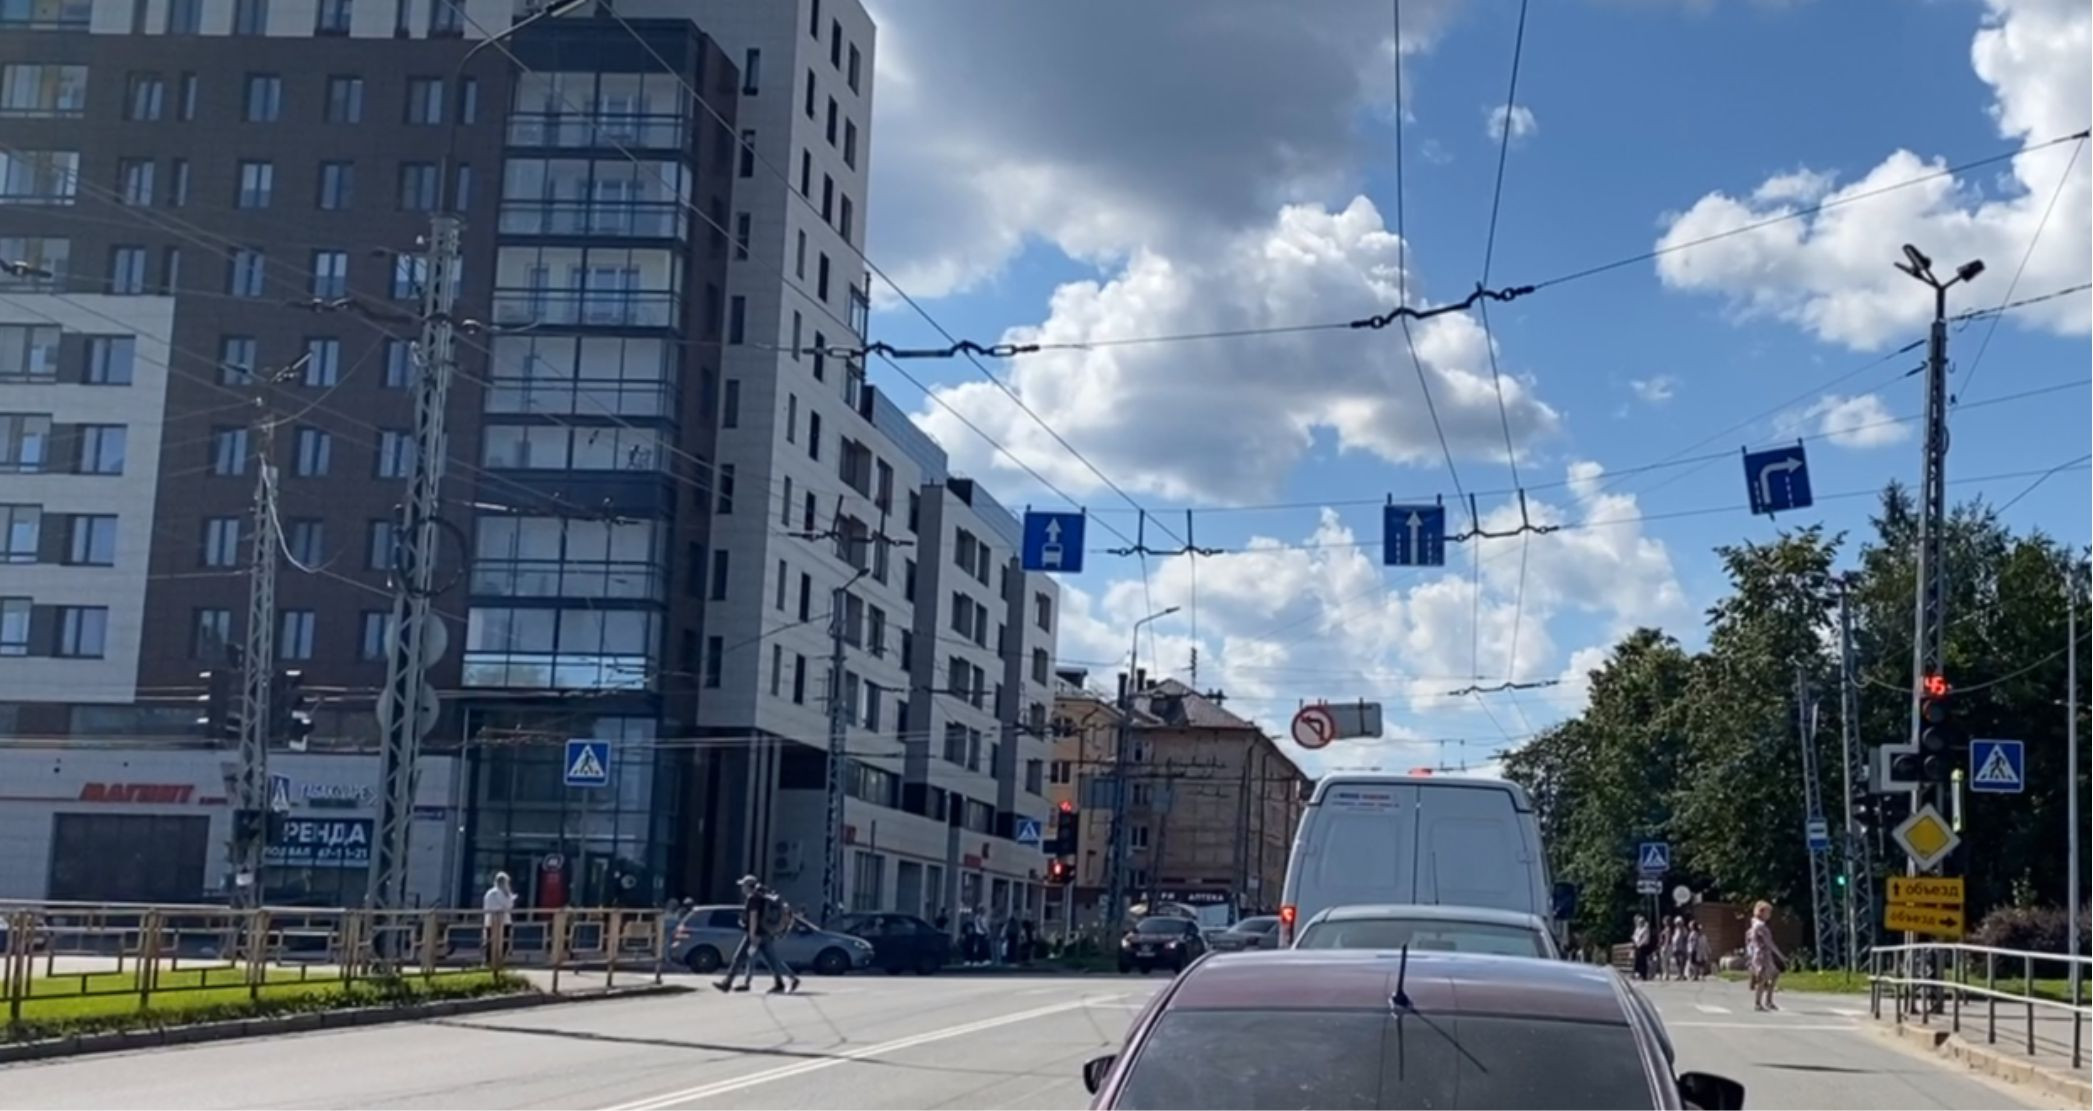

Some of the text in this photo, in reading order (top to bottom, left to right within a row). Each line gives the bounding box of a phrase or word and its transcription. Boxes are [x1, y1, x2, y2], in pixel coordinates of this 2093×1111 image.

[1924, 676, 1945, 695] 45
[283, 822, 366, 846] РЕНДА
[1906, 881, 1959, 897] объезд
[1188, 893, 1225, 902] АПТЕКА
[1891, 910, 1936, 926] объезд
